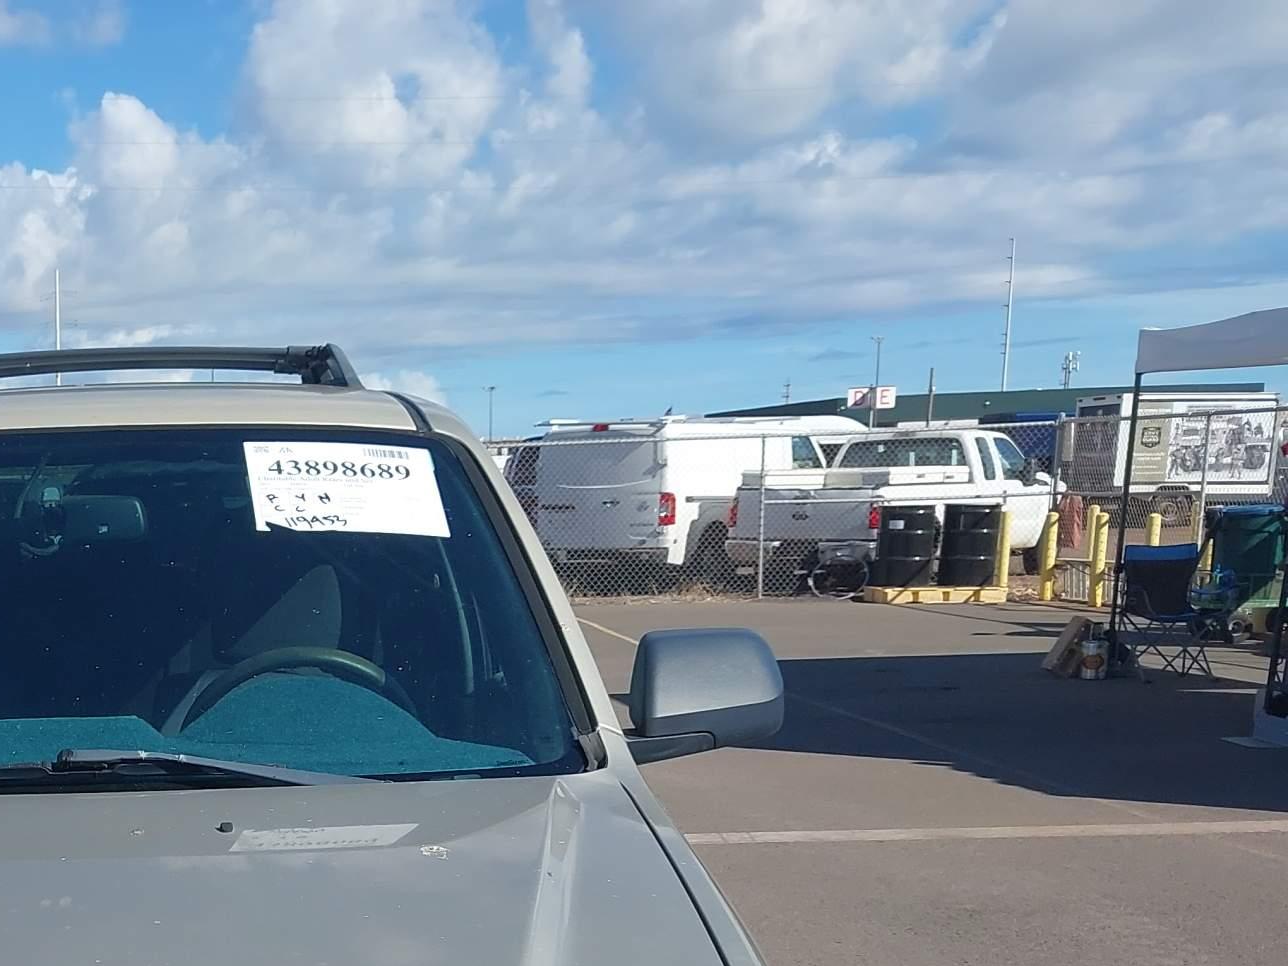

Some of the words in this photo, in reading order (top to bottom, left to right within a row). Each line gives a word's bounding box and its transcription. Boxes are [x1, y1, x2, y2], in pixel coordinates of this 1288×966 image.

[854, 390, 865, 407] D
[880, 389, 891, 405] E
[268, 459, 411, 481] 43898689
